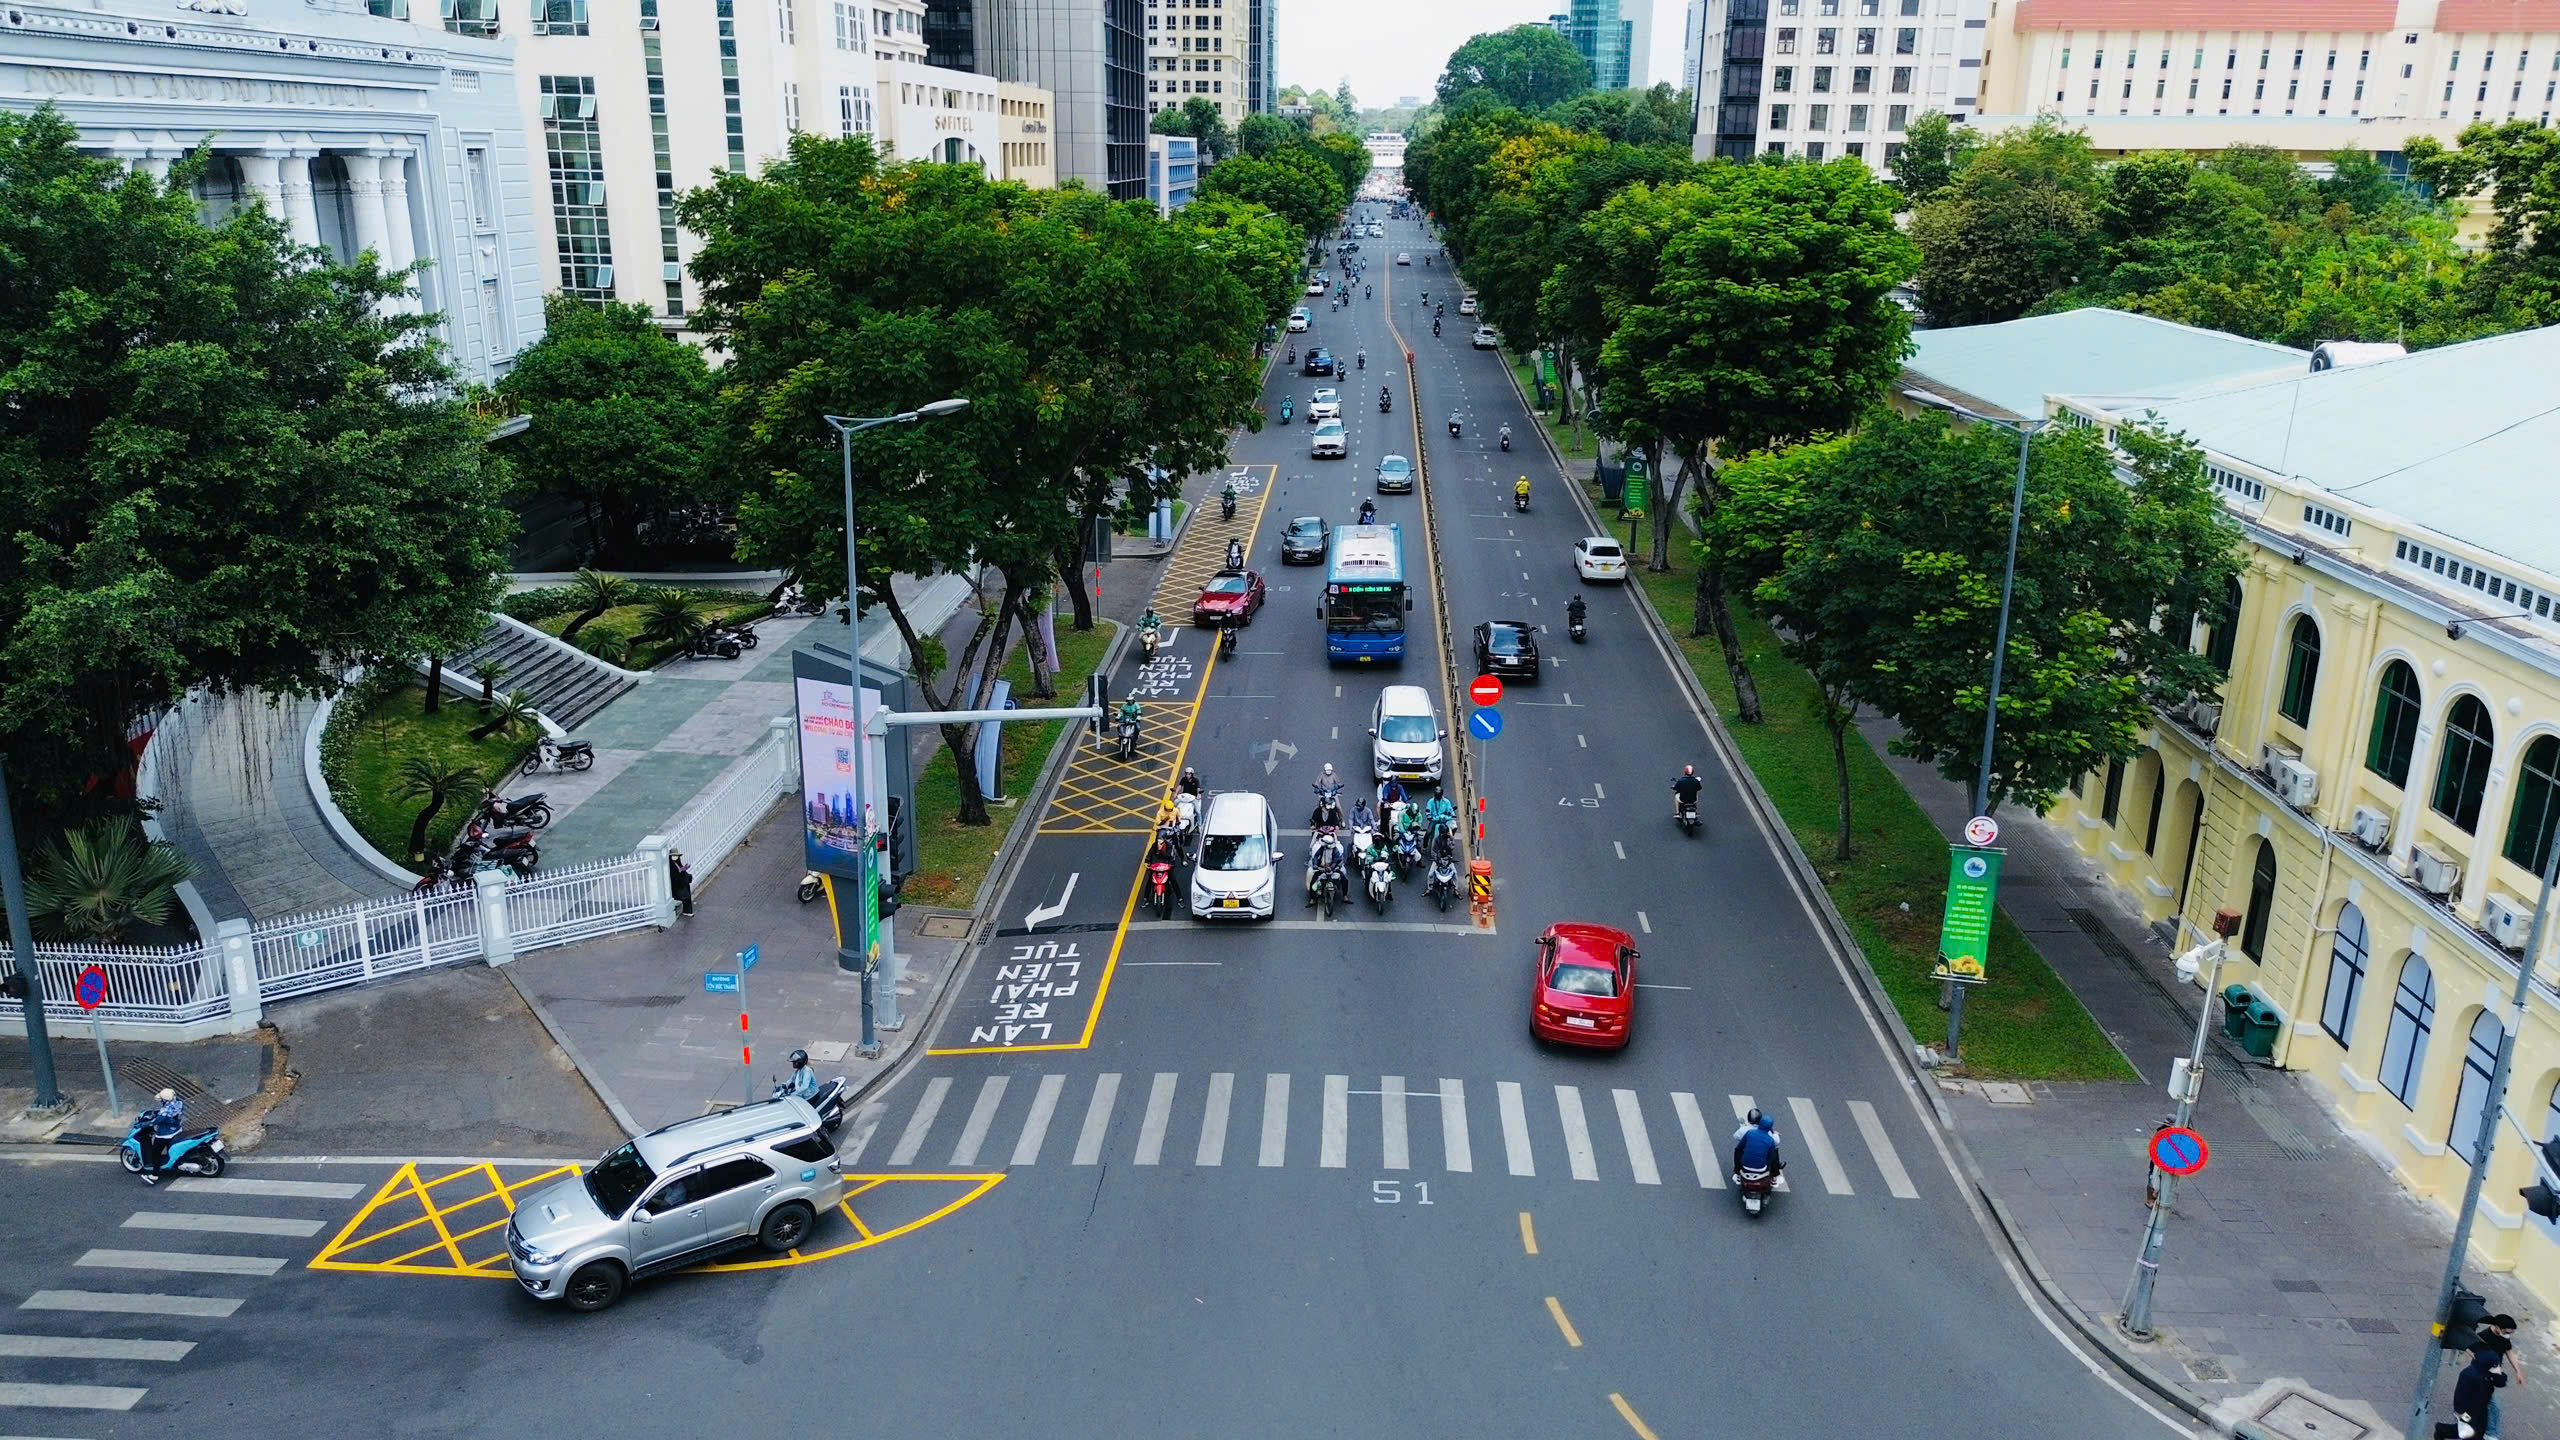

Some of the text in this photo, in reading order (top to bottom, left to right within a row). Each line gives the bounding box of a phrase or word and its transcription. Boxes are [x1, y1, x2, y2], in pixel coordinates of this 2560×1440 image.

[935, 116, 974, 132] SOFITEL
[1139, 664, 1192, 672] LIÊN
[1130, 688, 1180, 698] LÀN
[1558, 797, 1600, 807] 49
[1010, 941, 1080, 960] TỤC
[996, 962, 1080, 982] LIÊN
[990, 981, 1079, 1003] PHẢI
[970, 1023, 1052, 1046] LÀN
[1373, 1180, 1434, 1205] 51
